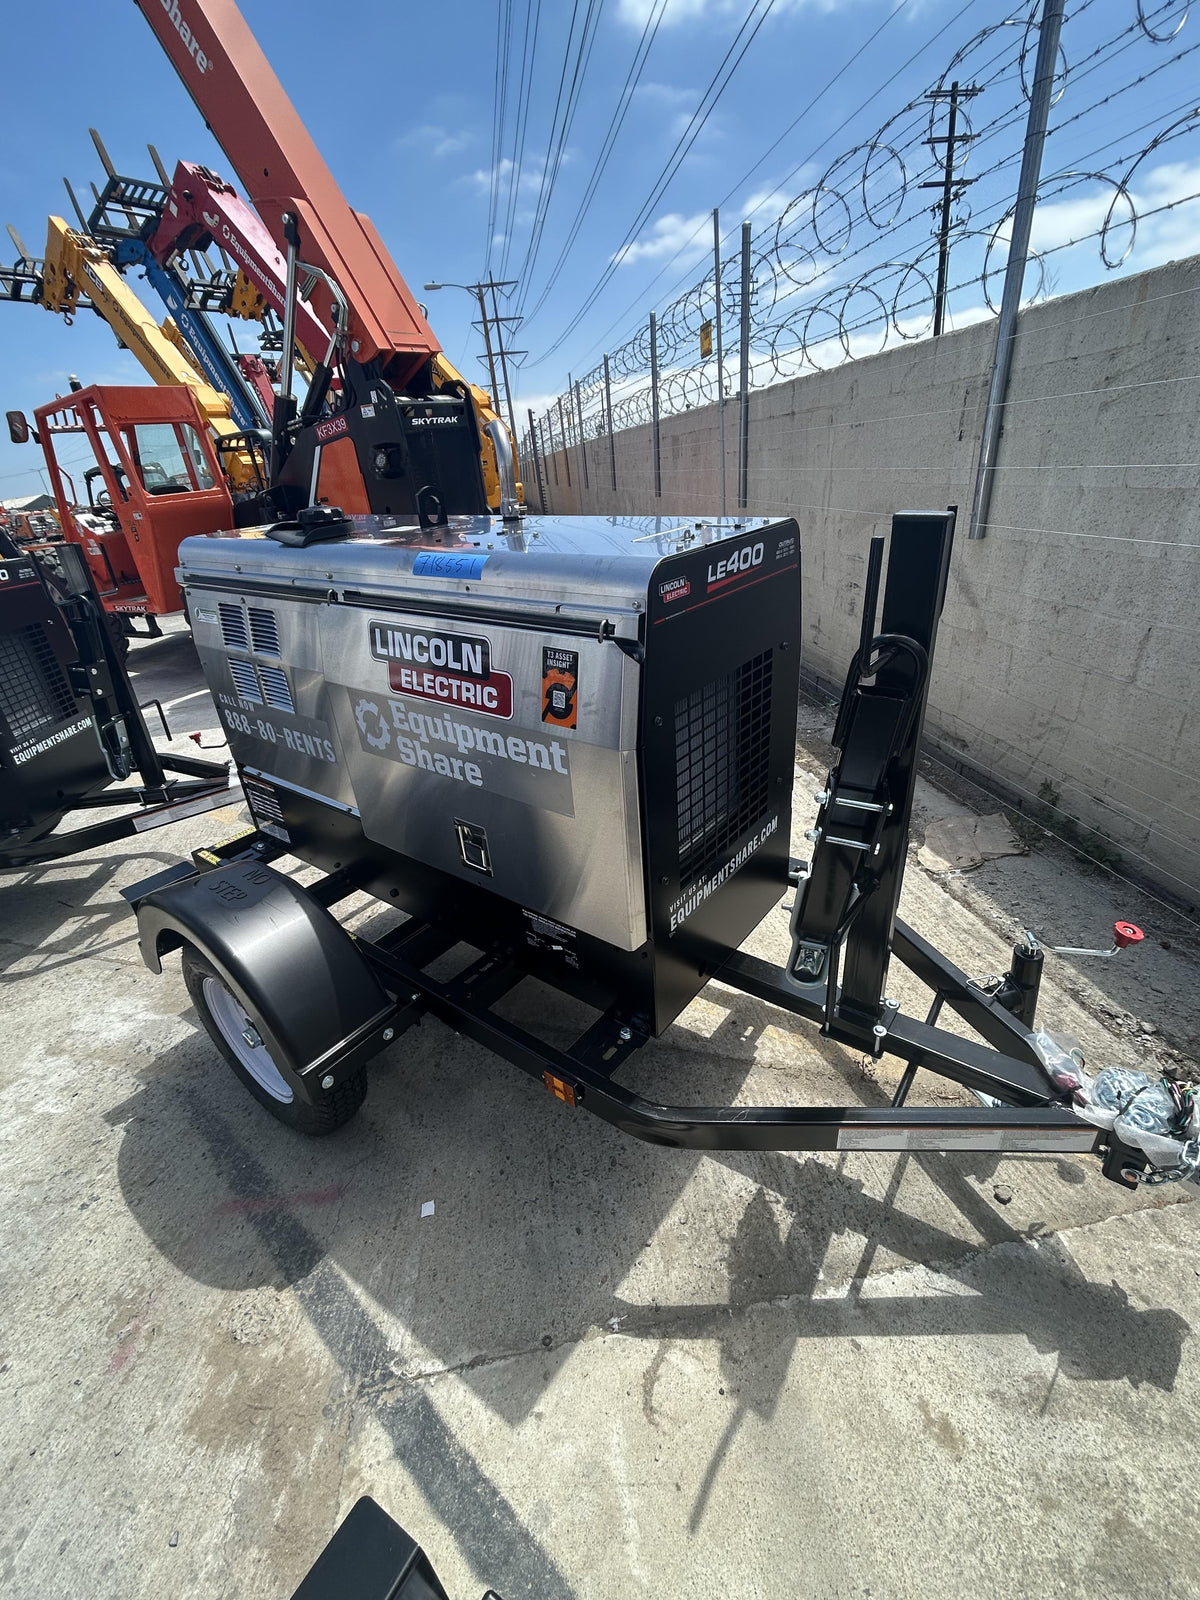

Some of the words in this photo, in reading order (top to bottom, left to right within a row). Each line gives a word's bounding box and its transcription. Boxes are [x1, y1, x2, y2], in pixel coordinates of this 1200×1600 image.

[316, 417, 348, 439] KF3X39
[411, 416, 458, 426] SKYTRAK
[419, 555, 477, 575] 718551
[707, 542, 765, 583] LE400
[660, 578, 685, 594] LINCOLN
[114, 605, 147, 613] SKYTRAK
[374, 628, 483, 675] LINCOLN
[546, 650, 555, 659] T3
[555, 652, 573, 662] ASSET
[400, 668, 498, 709] ELECTRIC
[218, 693, 237, 707] CALL
[238, 699, 255, 712] NOW
[13, 716, 93, 765] EQUIPMENTSHARE.COM
[224, 709, 336, 763] 888-80-RENTS
[388, 700, 568, 776] Equipment
[397, 735, 484, 787] Share
[242, 868, 272, 886] NO
[670, 815, 778, 932] EQUIPMENTSHARE.COM
[208, 880, 248, 902] STEP
[669, 893, 687, 913] VISIT
[688, 883, 697, 896] US
